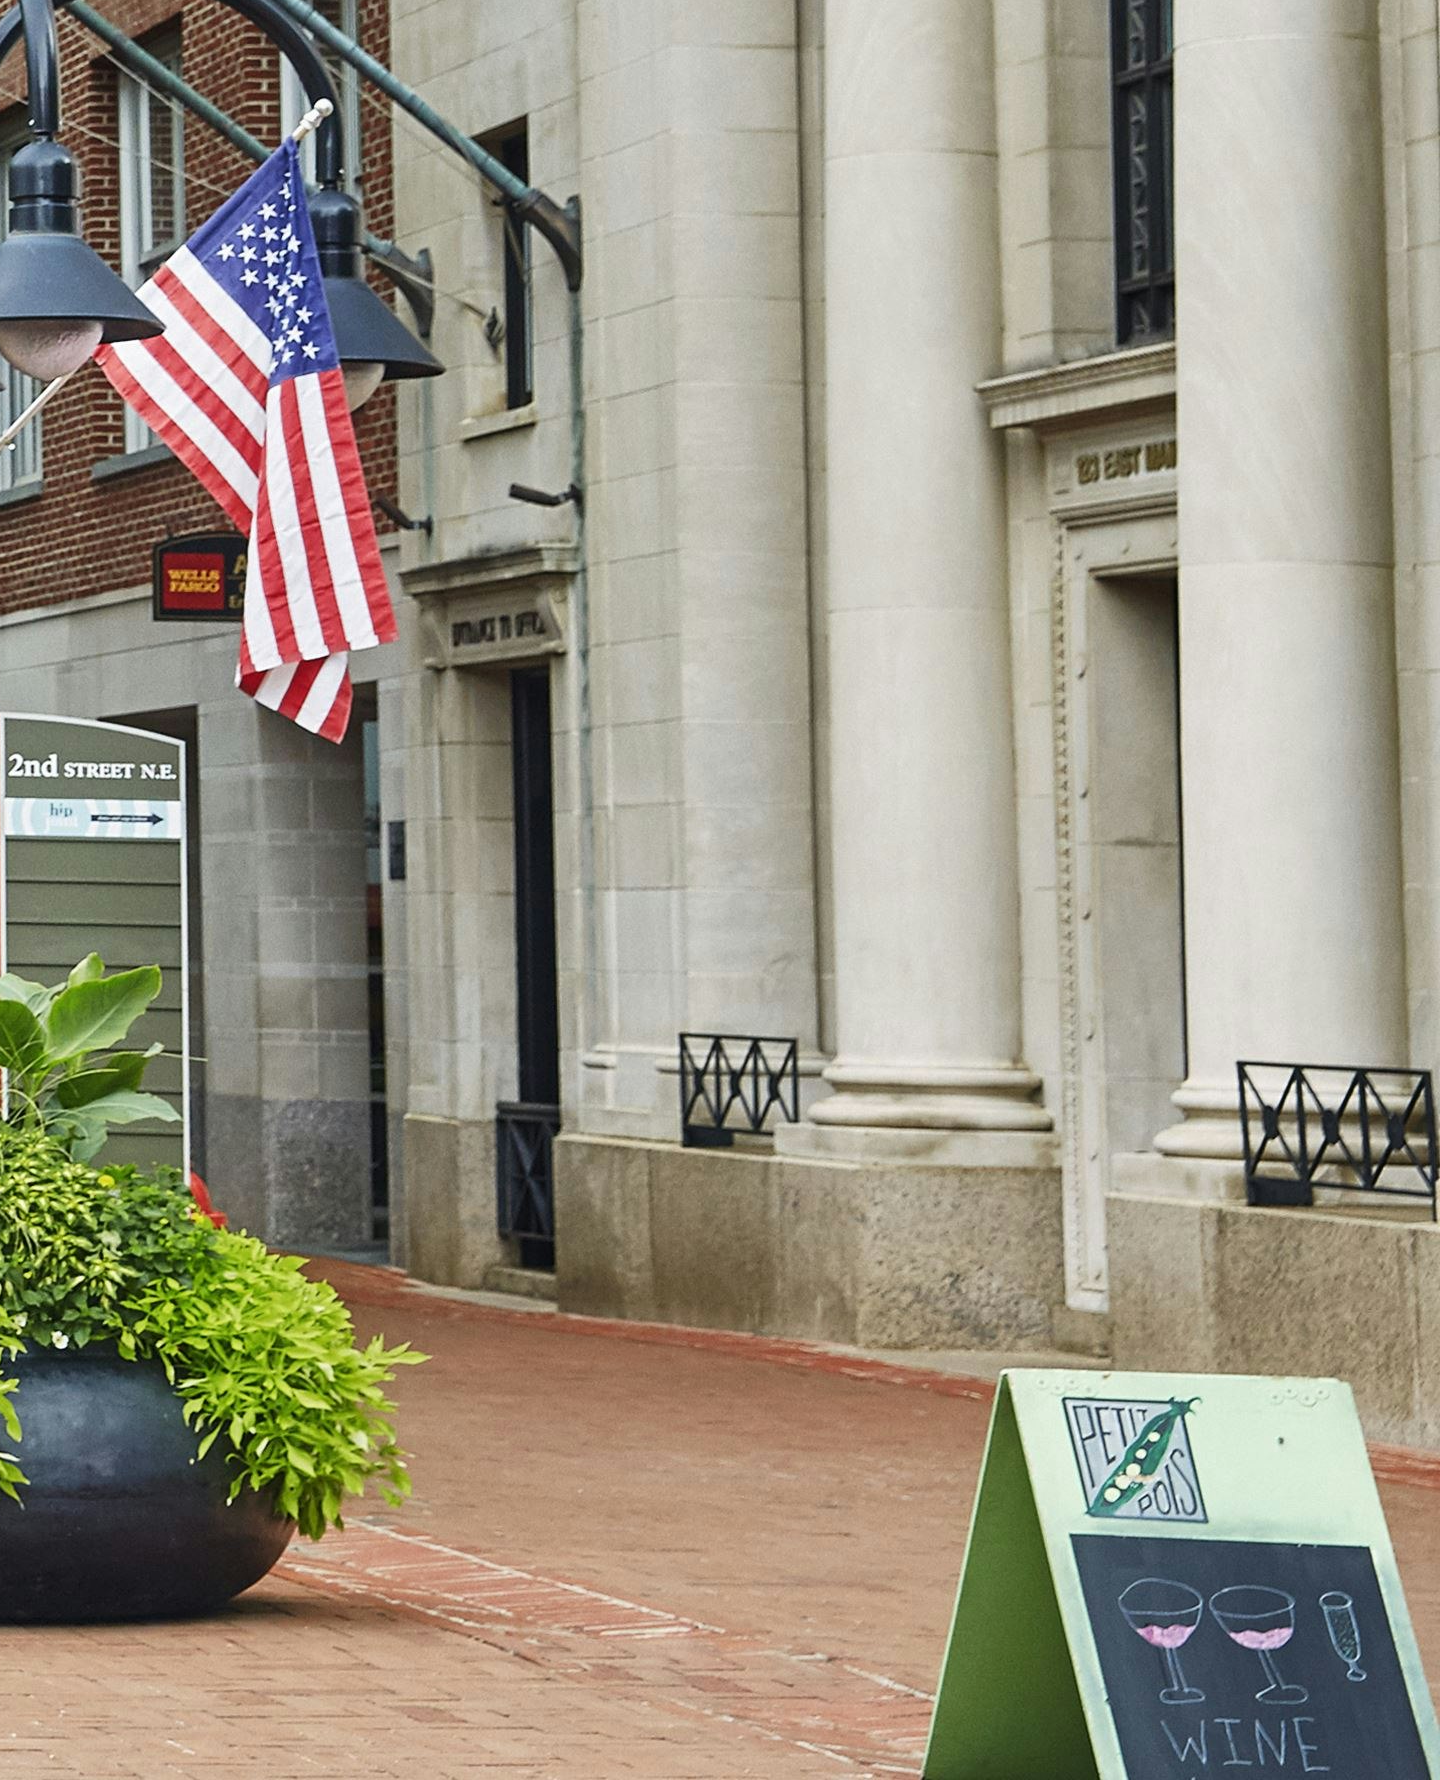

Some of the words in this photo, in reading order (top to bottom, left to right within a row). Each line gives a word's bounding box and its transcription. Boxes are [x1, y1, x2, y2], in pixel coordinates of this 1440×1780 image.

[167, 569, 220, 580] WELLS
[168, 581, 220, 593] FARGO
[7, 753, 59, 778] 2nd
[63, 762, 135, 779] STREET
[140, 764, 177, 780] N.E.
[49, 802, 73, 817] hip
[1072, 1404, 1148, 1489] PETIT
[1138, 1448, 1198, 1517] POIS
[1159, 1717, 1331, 1772] WINE
